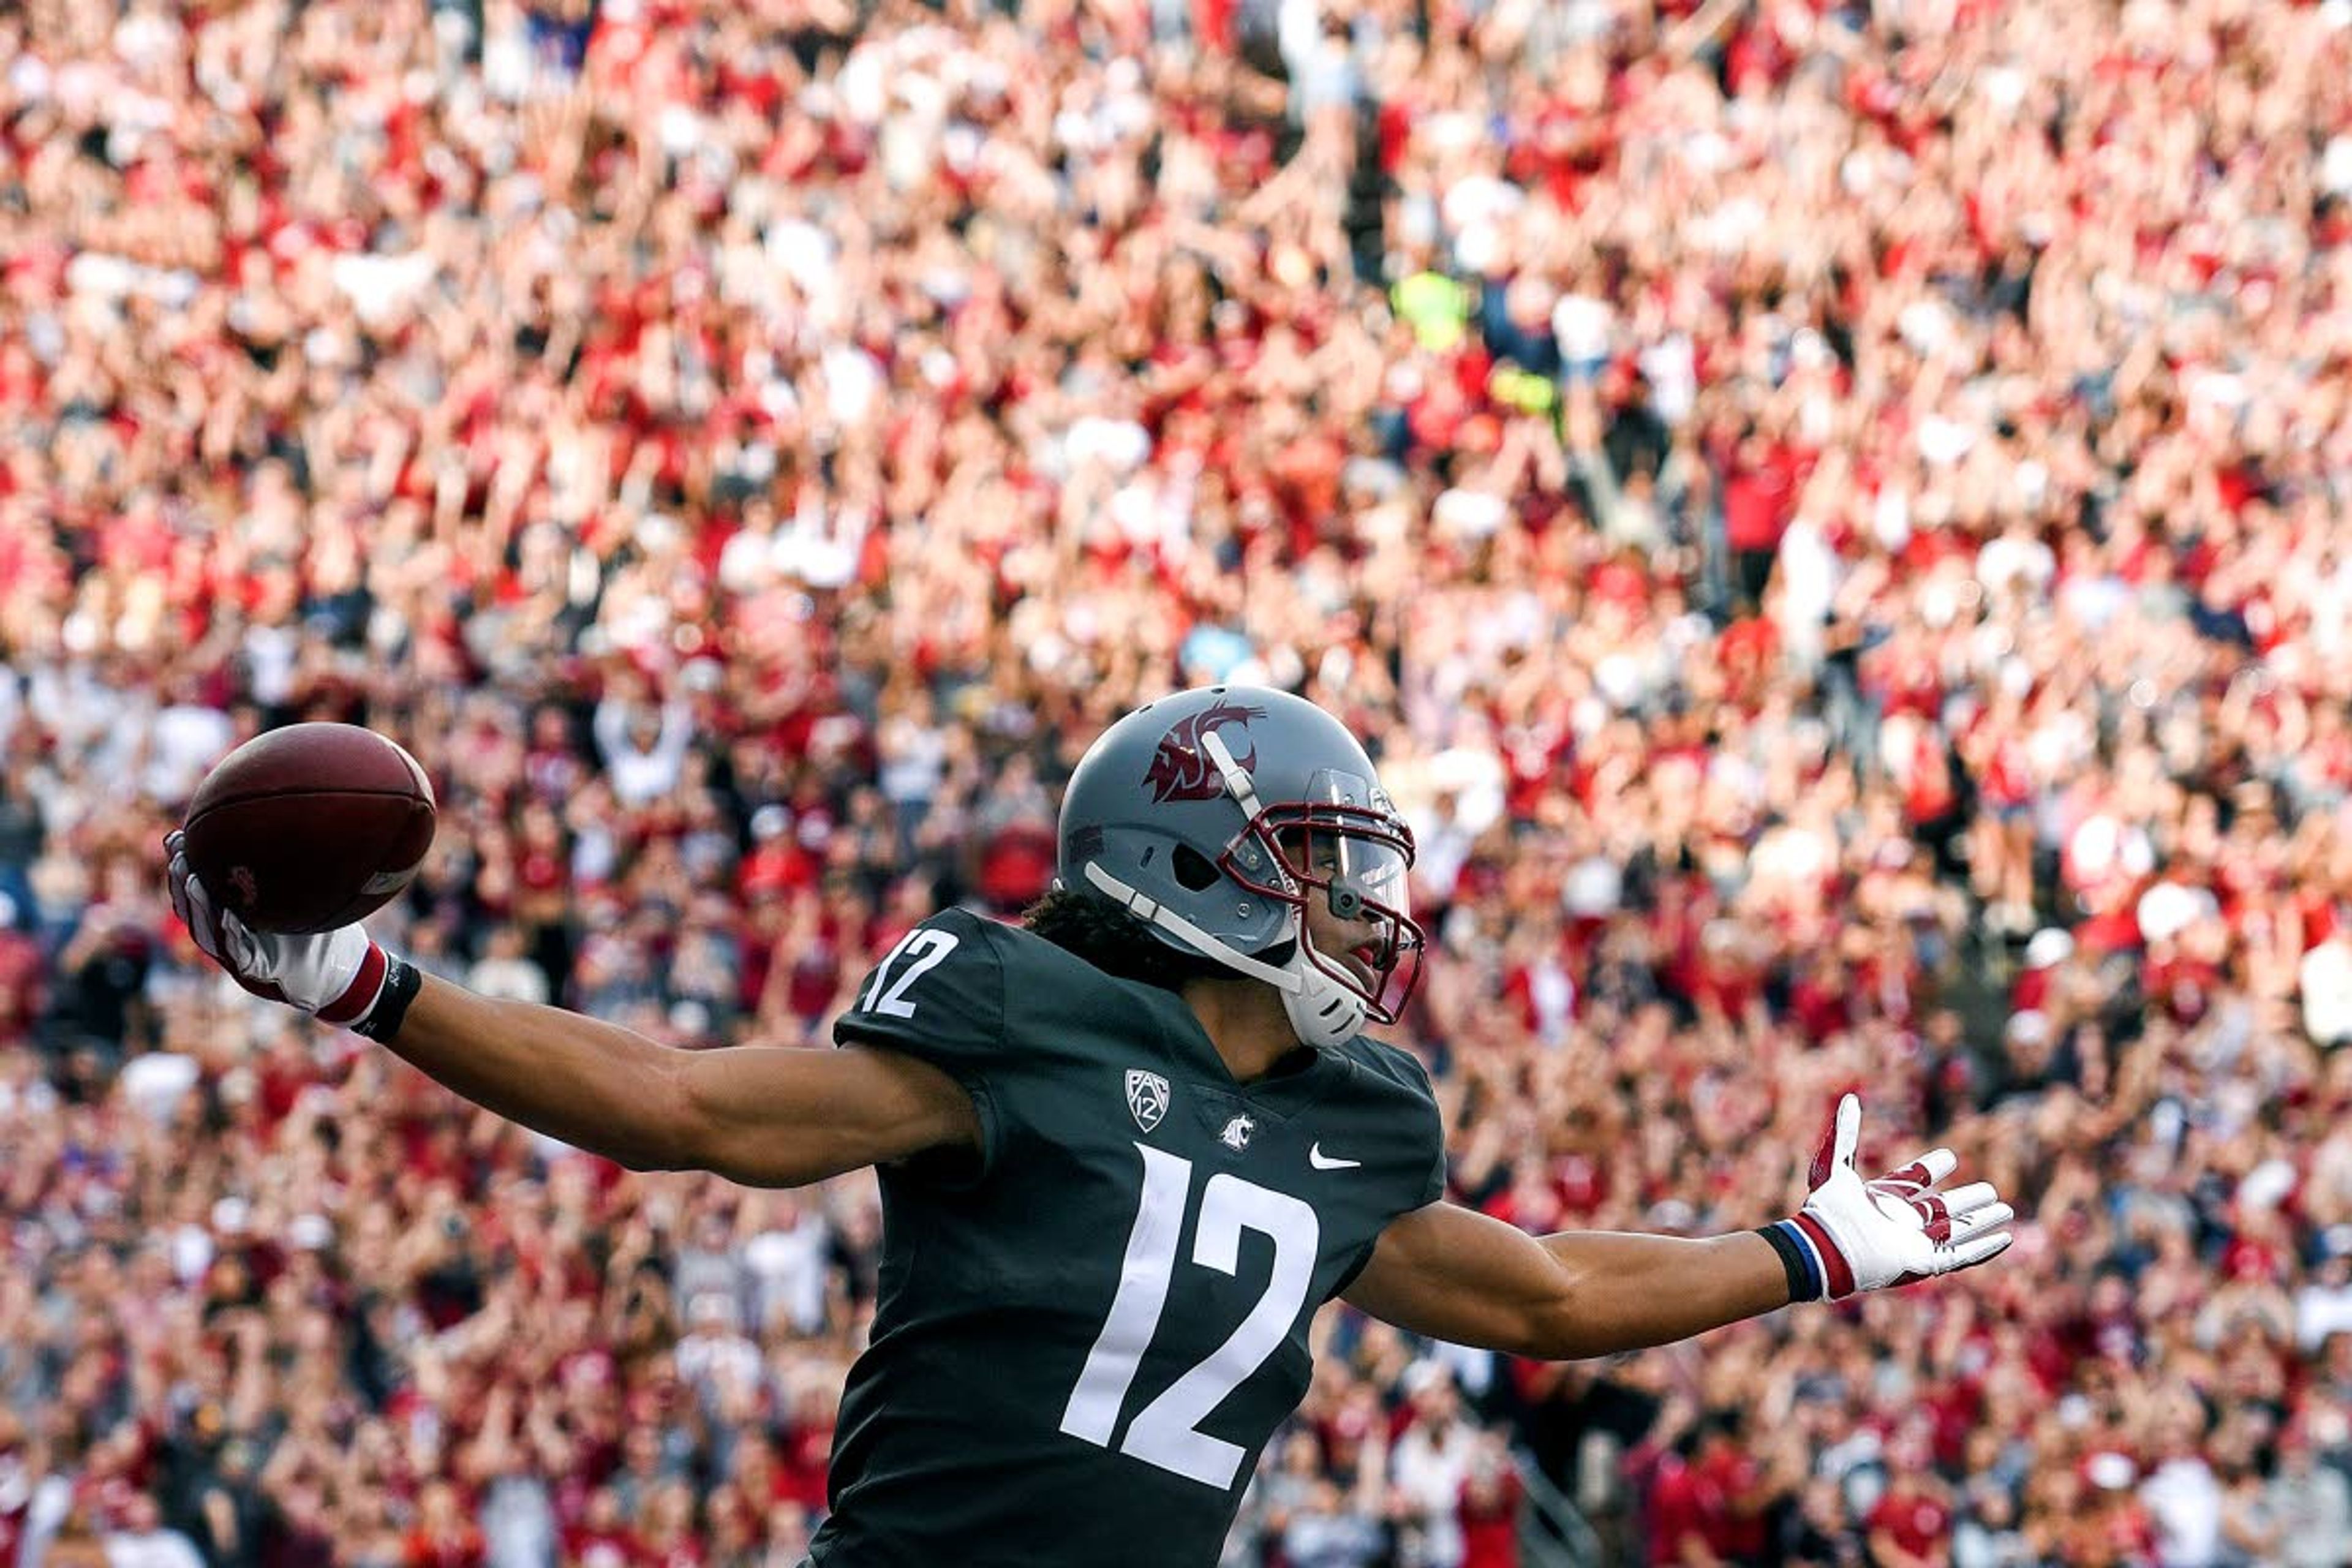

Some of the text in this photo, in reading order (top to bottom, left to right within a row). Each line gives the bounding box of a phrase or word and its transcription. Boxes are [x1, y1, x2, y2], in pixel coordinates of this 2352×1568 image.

[862, 928, 960, 1019] 12
[1127, 1071, 1168, 1112] PAC
[1136, 1096, 1158, 1121] 12
[1059, 1140, 1321, 1491] 12
